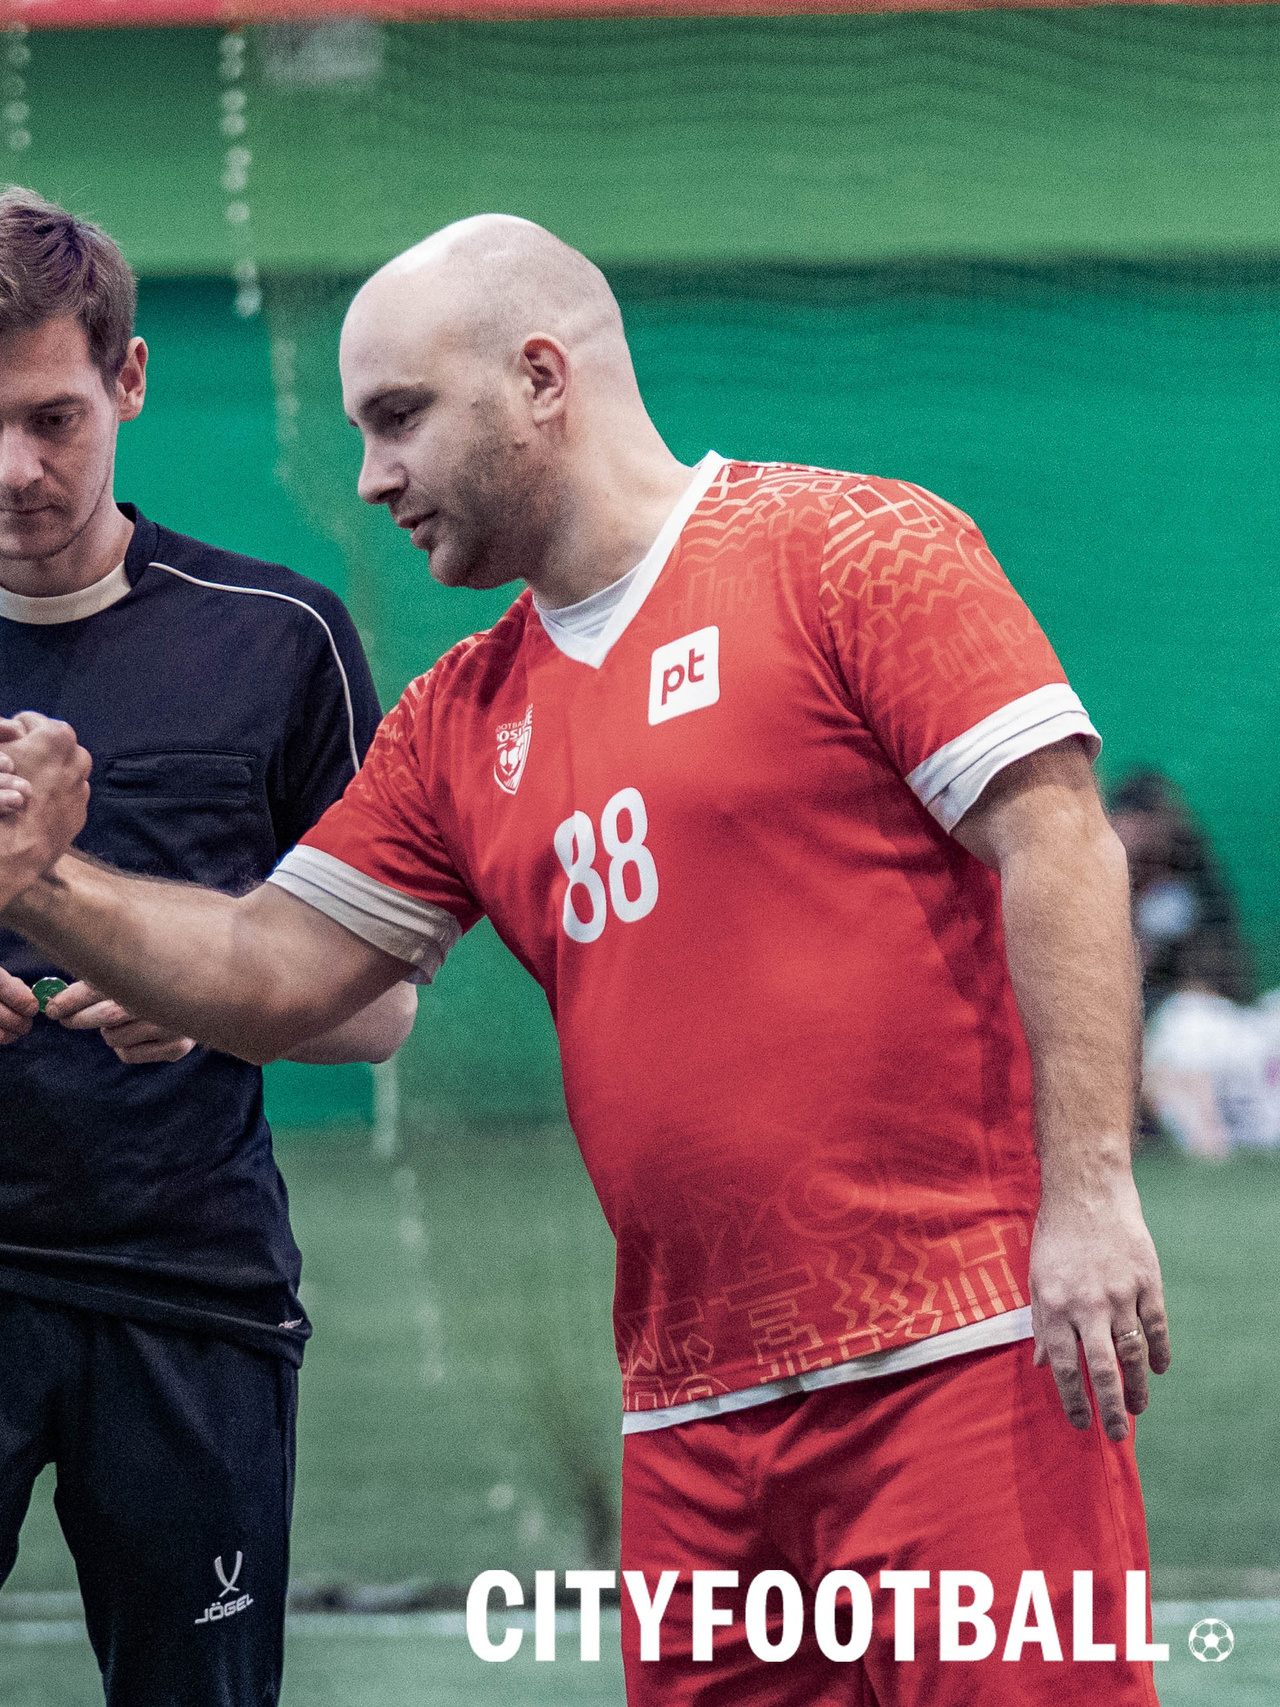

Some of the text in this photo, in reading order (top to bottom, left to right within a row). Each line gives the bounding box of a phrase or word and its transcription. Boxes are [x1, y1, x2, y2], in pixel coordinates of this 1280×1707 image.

[661, 648, 705, 706] pt
[554, 786, 659, 944] 88
[194, 1593, 254, 1624] JÖGEL
